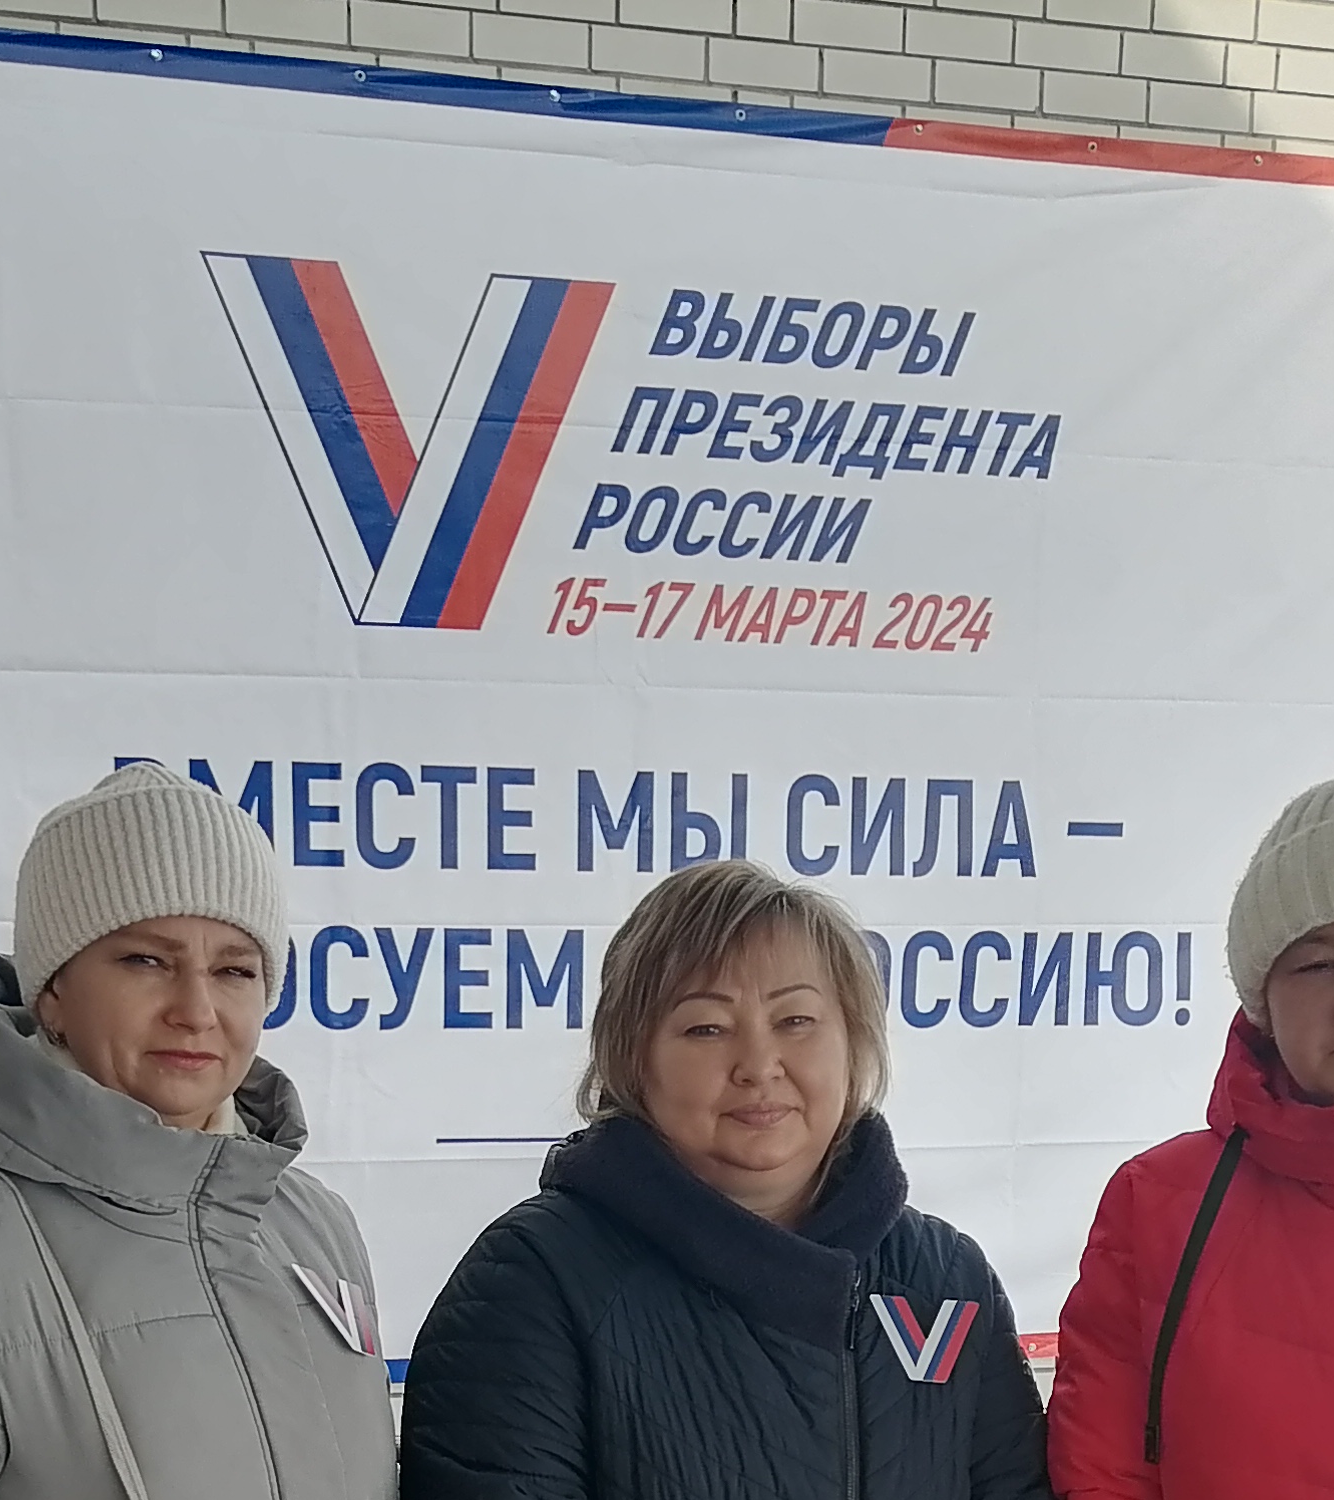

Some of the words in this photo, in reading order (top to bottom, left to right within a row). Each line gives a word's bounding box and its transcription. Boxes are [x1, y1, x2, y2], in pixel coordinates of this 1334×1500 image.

[648, 288, 976, 377] ВЫБОРЫ
[610, 386, 1062, 480] ПРЕЗИДЕНТА
[572, 483, 873, 564] РОССИИ
[694, 583, 868, 648] МАРТА
[872, 593, 995, 652] 2024
[114, 756, 537, 871] МЕСТЕ
[576, 769, 749, 873] МЫ
[785, 774, 1037, 878] СИЛА
